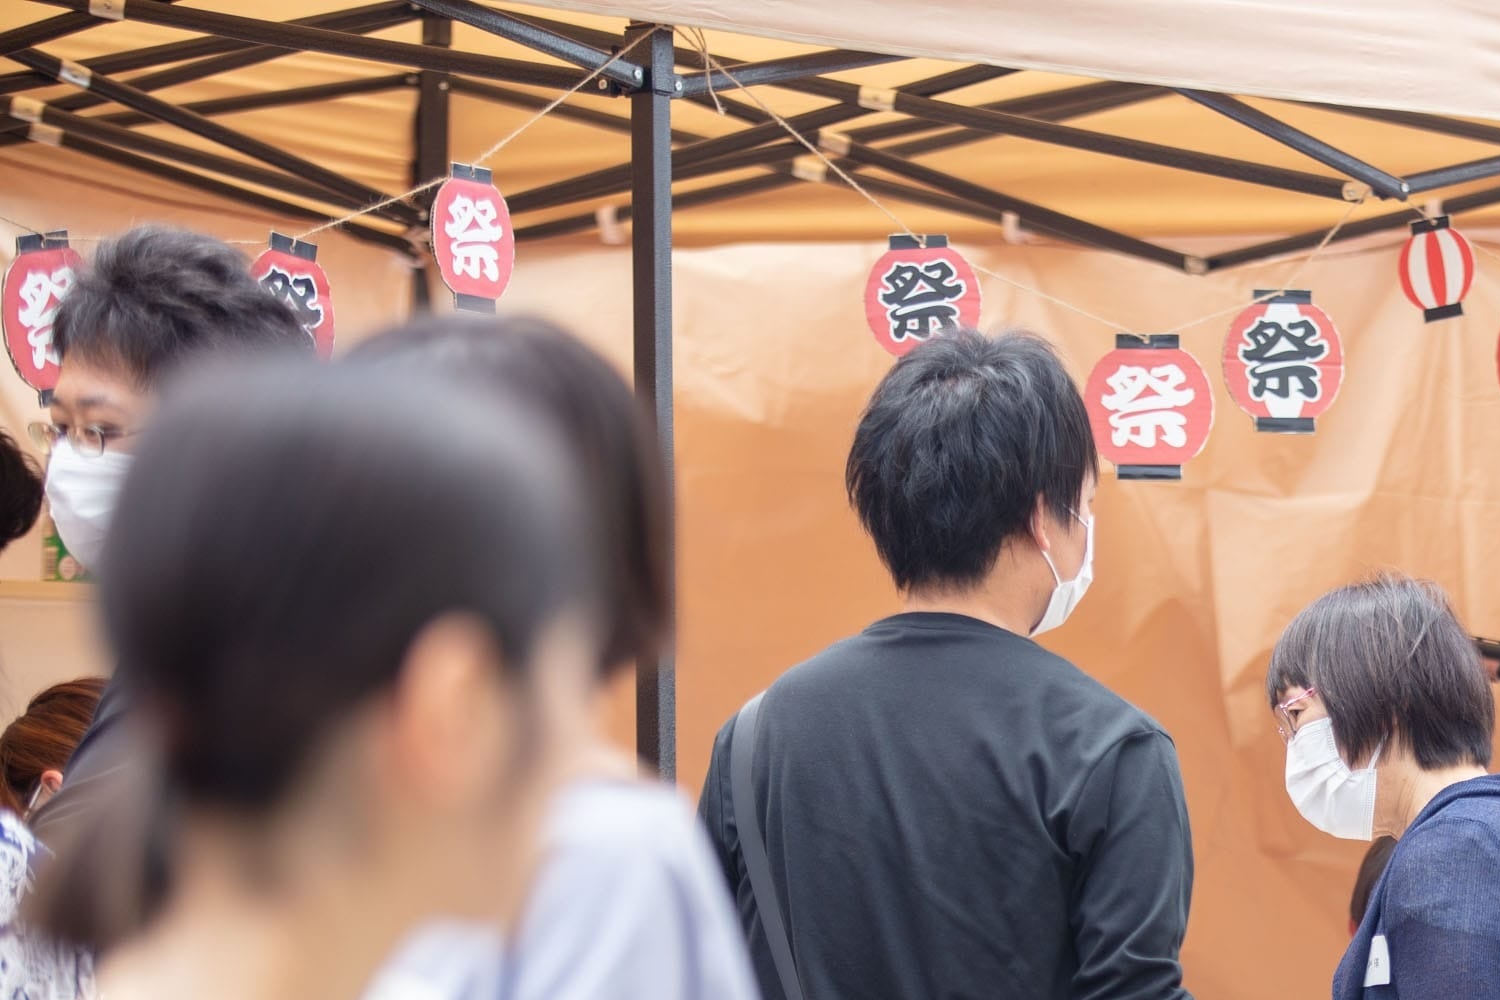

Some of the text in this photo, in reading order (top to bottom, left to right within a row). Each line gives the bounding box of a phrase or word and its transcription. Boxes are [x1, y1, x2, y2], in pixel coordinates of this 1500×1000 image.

[444, 192, 504, 283] 祭
[878, 259, 966, 342] 祭
[1239, 319, 1328, 402] 祭
[1101, 364, 1196, 448] 祭
